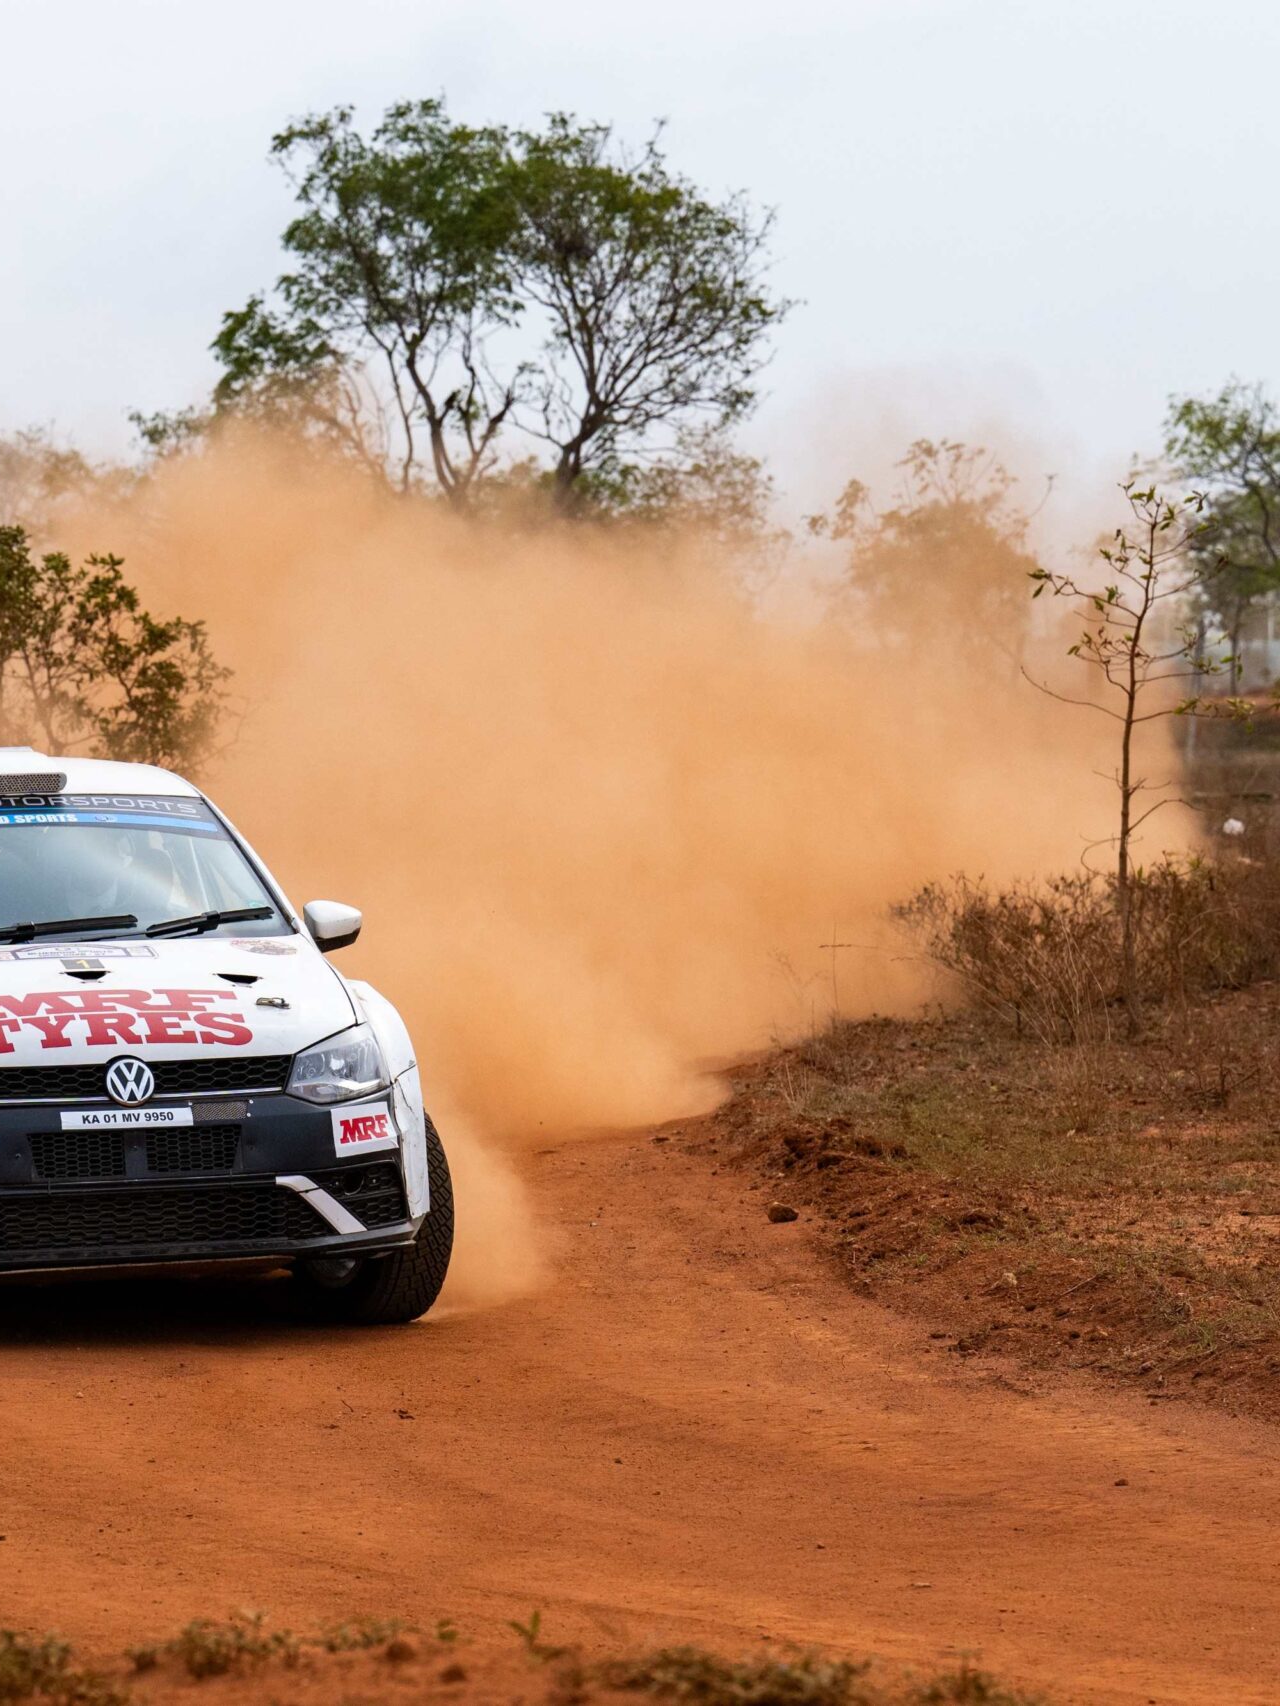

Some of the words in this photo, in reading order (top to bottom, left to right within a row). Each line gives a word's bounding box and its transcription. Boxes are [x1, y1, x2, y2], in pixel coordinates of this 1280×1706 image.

[14, 813, 78, 823] SPORTS
[76, 959, 90, 969] 1
[82, 1114, 100, 1124] KA
[103, 1113, 117, 1124] 01
[122, 1112, 140, 1123] MV
[145, 1112, 174, 1122] 9950
[339, 1114, 389, 1145] MRF
